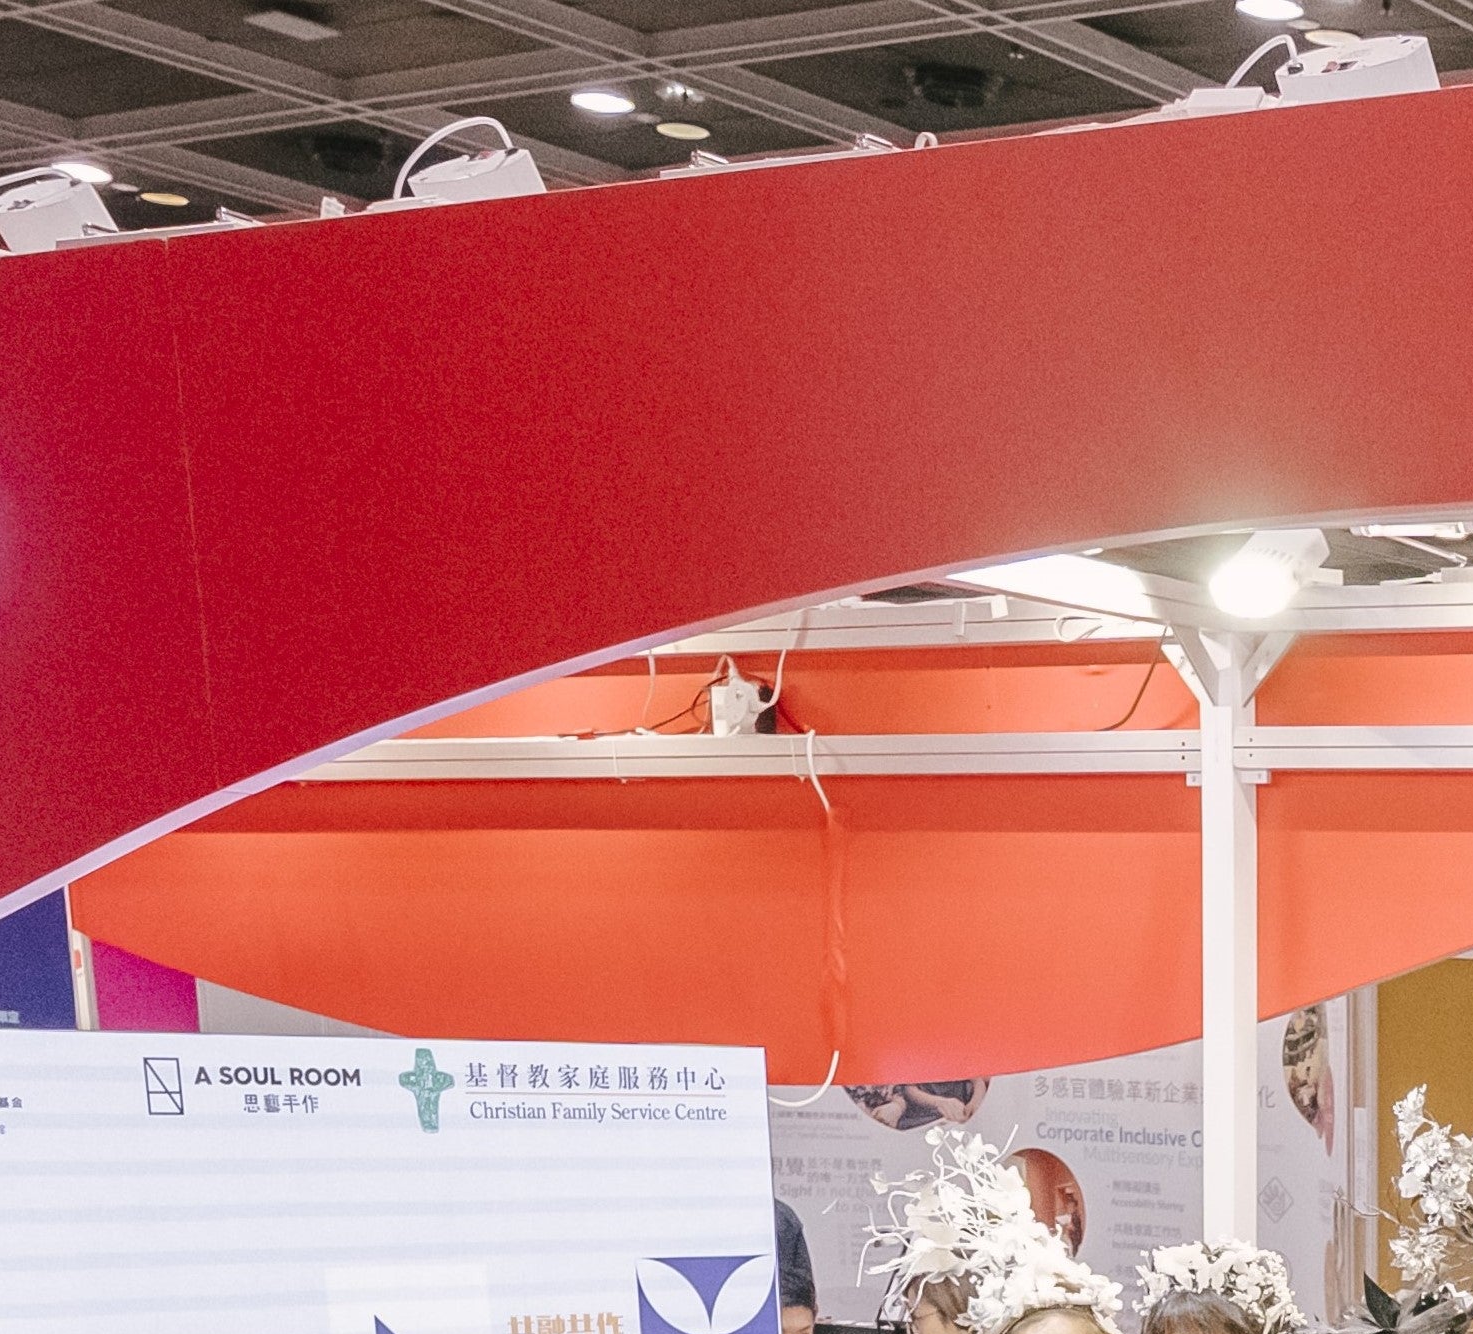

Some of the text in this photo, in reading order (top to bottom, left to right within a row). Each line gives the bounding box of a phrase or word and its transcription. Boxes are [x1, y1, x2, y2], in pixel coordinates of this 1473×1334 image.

[195, 1066, 362, 1087] A SOUL ROOM
[464, 1062, 726, 1092] 基督教家庭服務中心
[1034, 1075, 1204, 1105] 多感官體驗革新企業
[243, 1094, 319, 1114] 思藝手作
[469, 1101, 727, 1125] Christian Family Service Centre
[1036, 1121, 1114, 1144] Corporate
[1119, 1123, 1187, 1147] Inclusive
